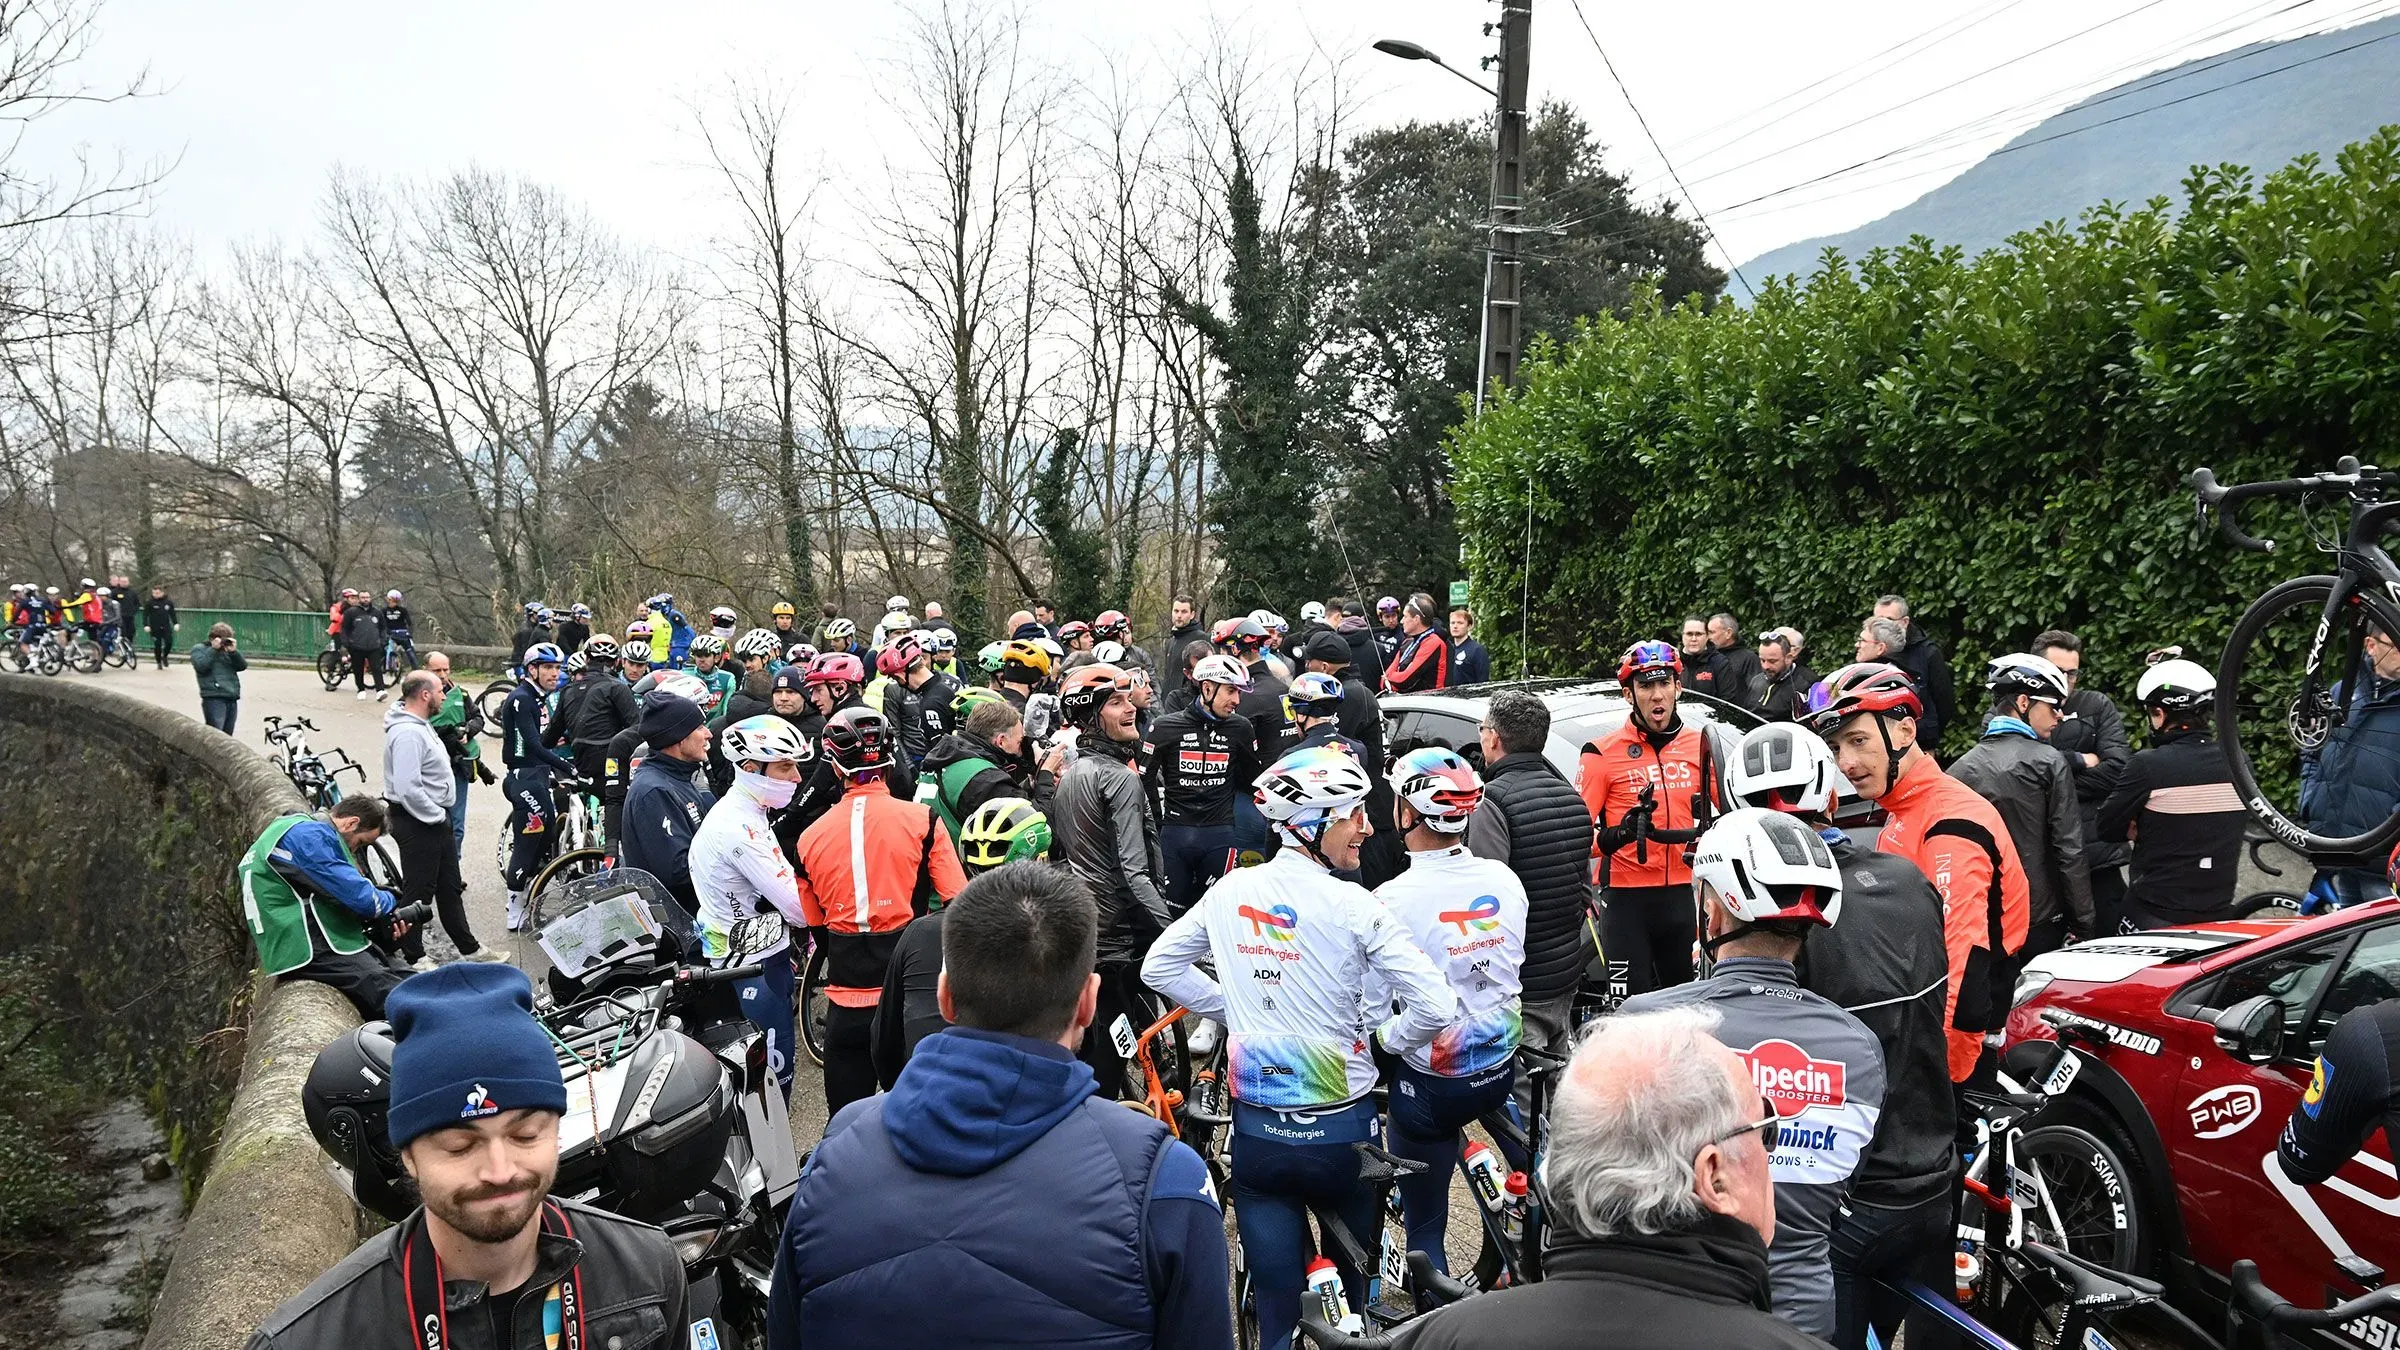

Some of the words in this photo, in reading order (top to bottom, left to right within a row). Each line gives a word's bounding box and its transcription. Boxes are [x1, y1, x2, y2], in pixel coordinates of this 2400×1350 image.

[1280, 727, 1298, 737] TRE
[1180, 761, 1227, 772] SOUDAL
[1627, 762, 1691, 785] INEOS
[1401, 776, 1440, 797] HJC
[1629, 781, 1692, 793] GRNADIER
[520, 789, 542, 813] BORA
[2249, 796, 2273, 819] DT
[2269, 817, 2309, 848] SWISS
[1236, 943, 1301, 962] TotalEnergies
[1447, 936, 1505, 957] TotalEnergies
[1253, 969, 1281, 981] ADM
[1764, 986, 1803, 1001] crelan
[1115, 1027, 1132, 1056] 184
[2105, 1024, 2161, 1056] RADIO
[1470, 1067, 1510, 1088] TotalEnergies
[1752, 1057, 1831, 1098] lpecin
[2051, 1061, 2074, 1092] 205
[1768, 1088, 1831, 1103] BOOSTER
[1263, 1123, 1326, 1140] TotalEnergies
[1767, 1155, 1801, 1167] DOWS
[2090, 1152, 2121, 1198] SWISS
[2015, 1178, 2038, 1206] 76
[2112, 1201, 2128, 1229] DT
[1386, 1244, 1402, 1284] 125
[563, 1281, 575, 1316] 90D
[1322, 1284, 1341, 1324] GARMIN
[2085, 1292, 2116, 1304] italia
[2054, 1304, 2070, 1345] CANYON
